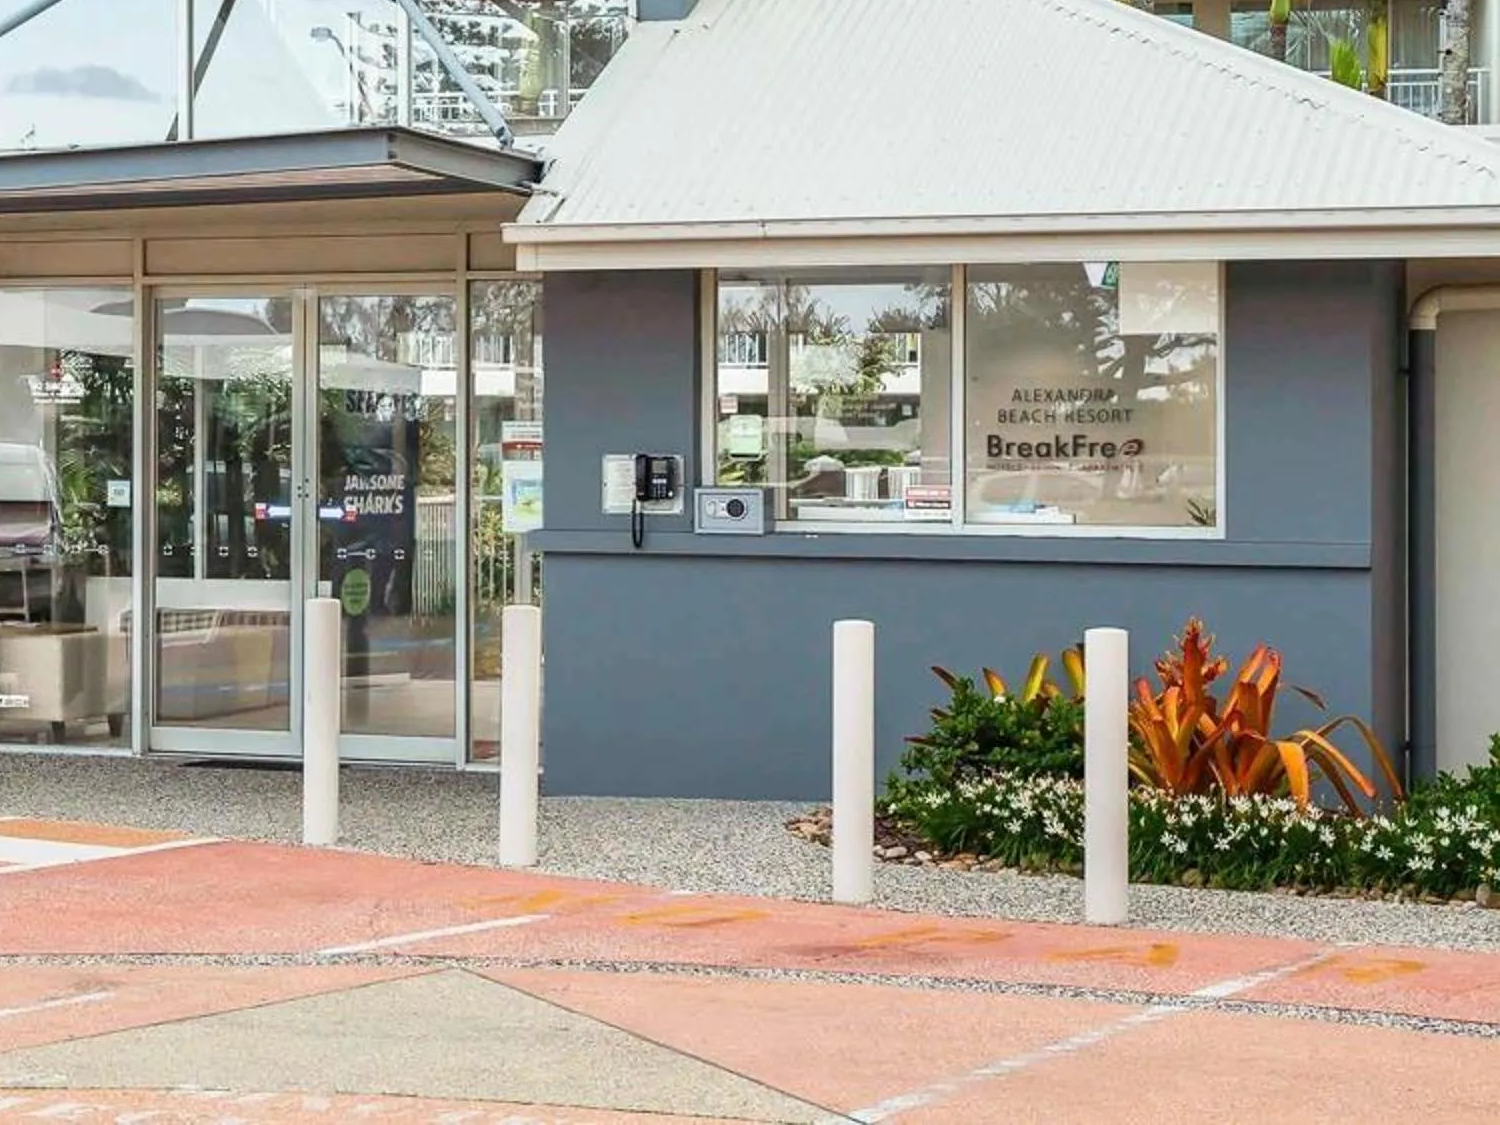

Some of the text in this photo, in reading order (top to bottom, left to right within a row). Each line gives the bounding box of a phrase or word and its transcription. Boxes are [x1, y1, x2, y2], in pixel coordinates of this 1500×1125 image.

[1011, 388, 1117, 402] ALEXANDRA
[998, 409, 1132, 424] BEACH RESORT
